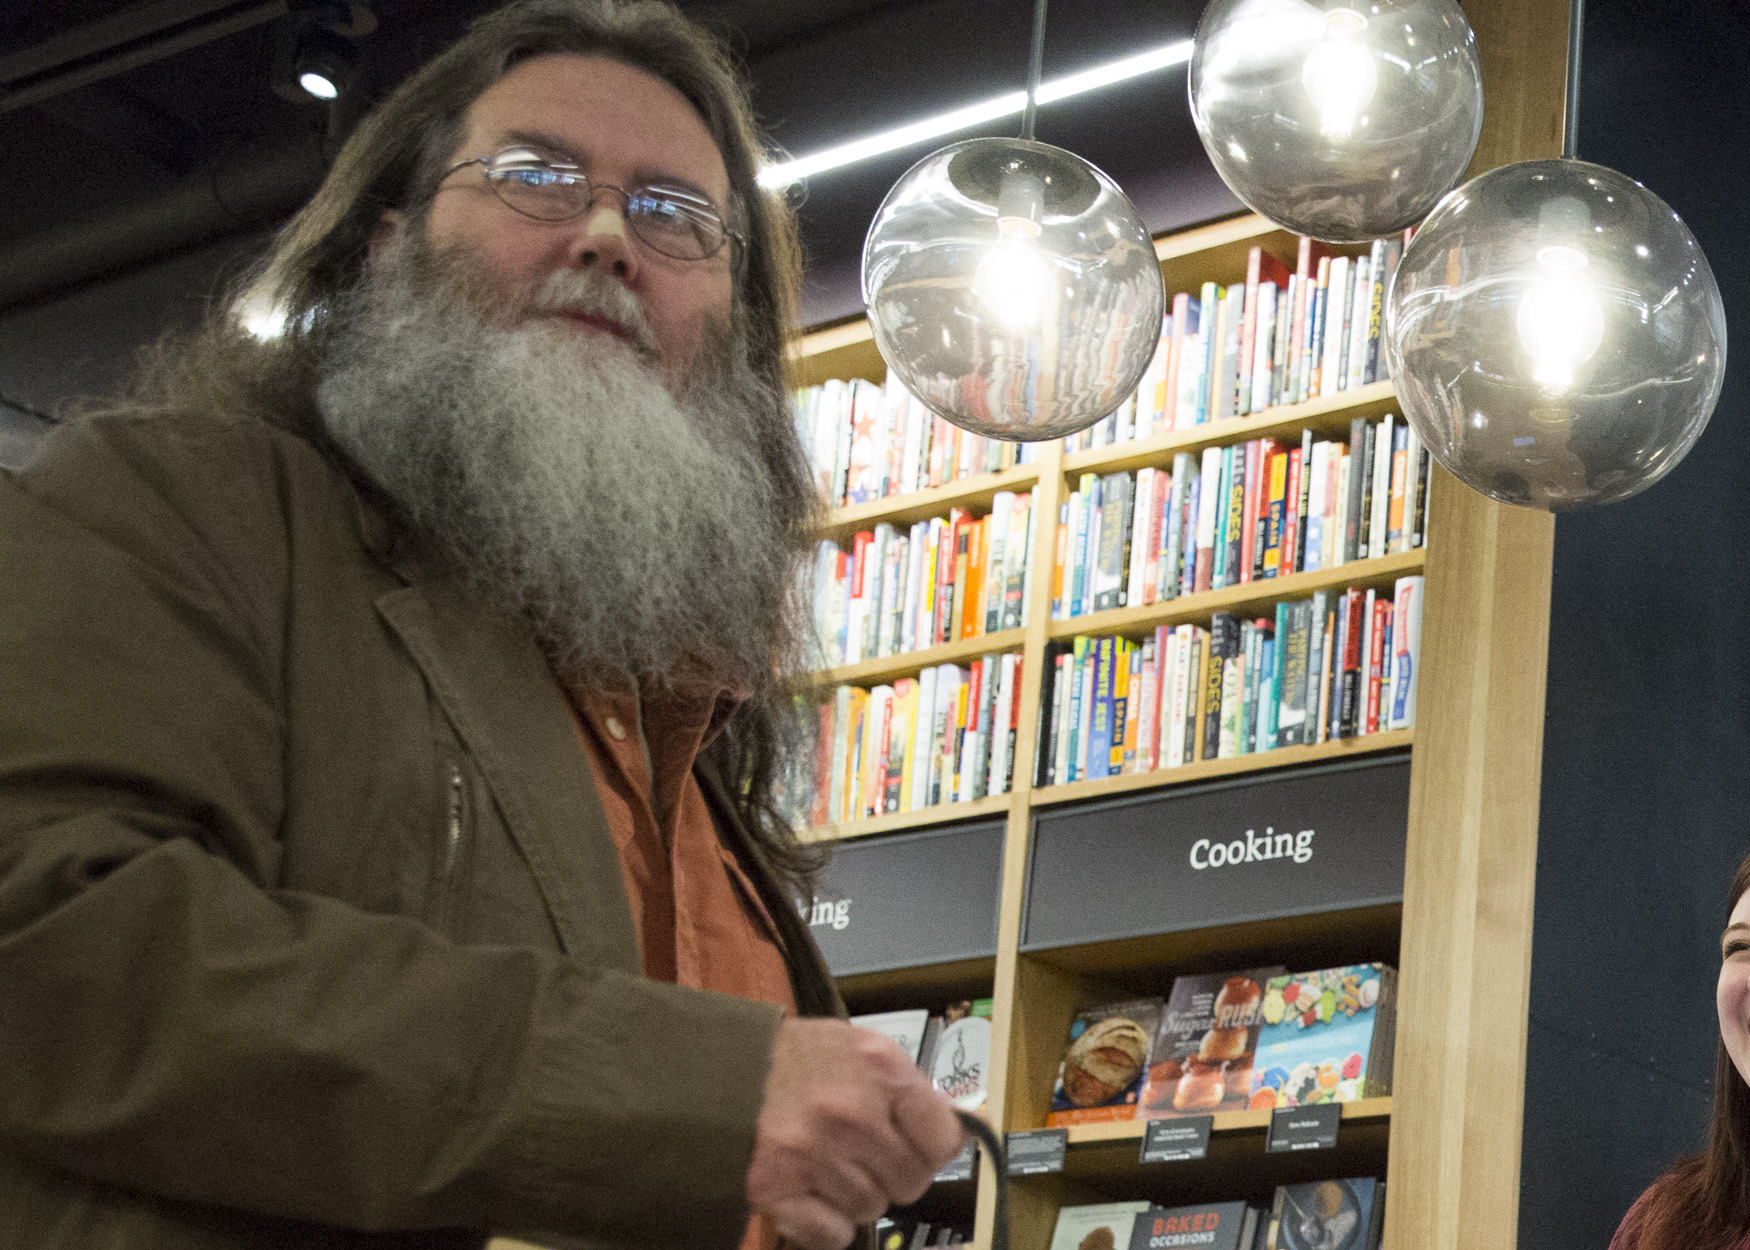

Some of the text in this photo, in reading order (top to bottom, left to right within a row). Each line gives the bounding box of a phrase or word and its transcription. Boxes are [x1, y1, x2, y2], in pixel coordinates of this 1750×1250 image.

[1206, 655, 1224, 714] SIDES
[1190, 826, 1315, 871] Cooking
[1152, 1212, 1220, 1236] BAKED
